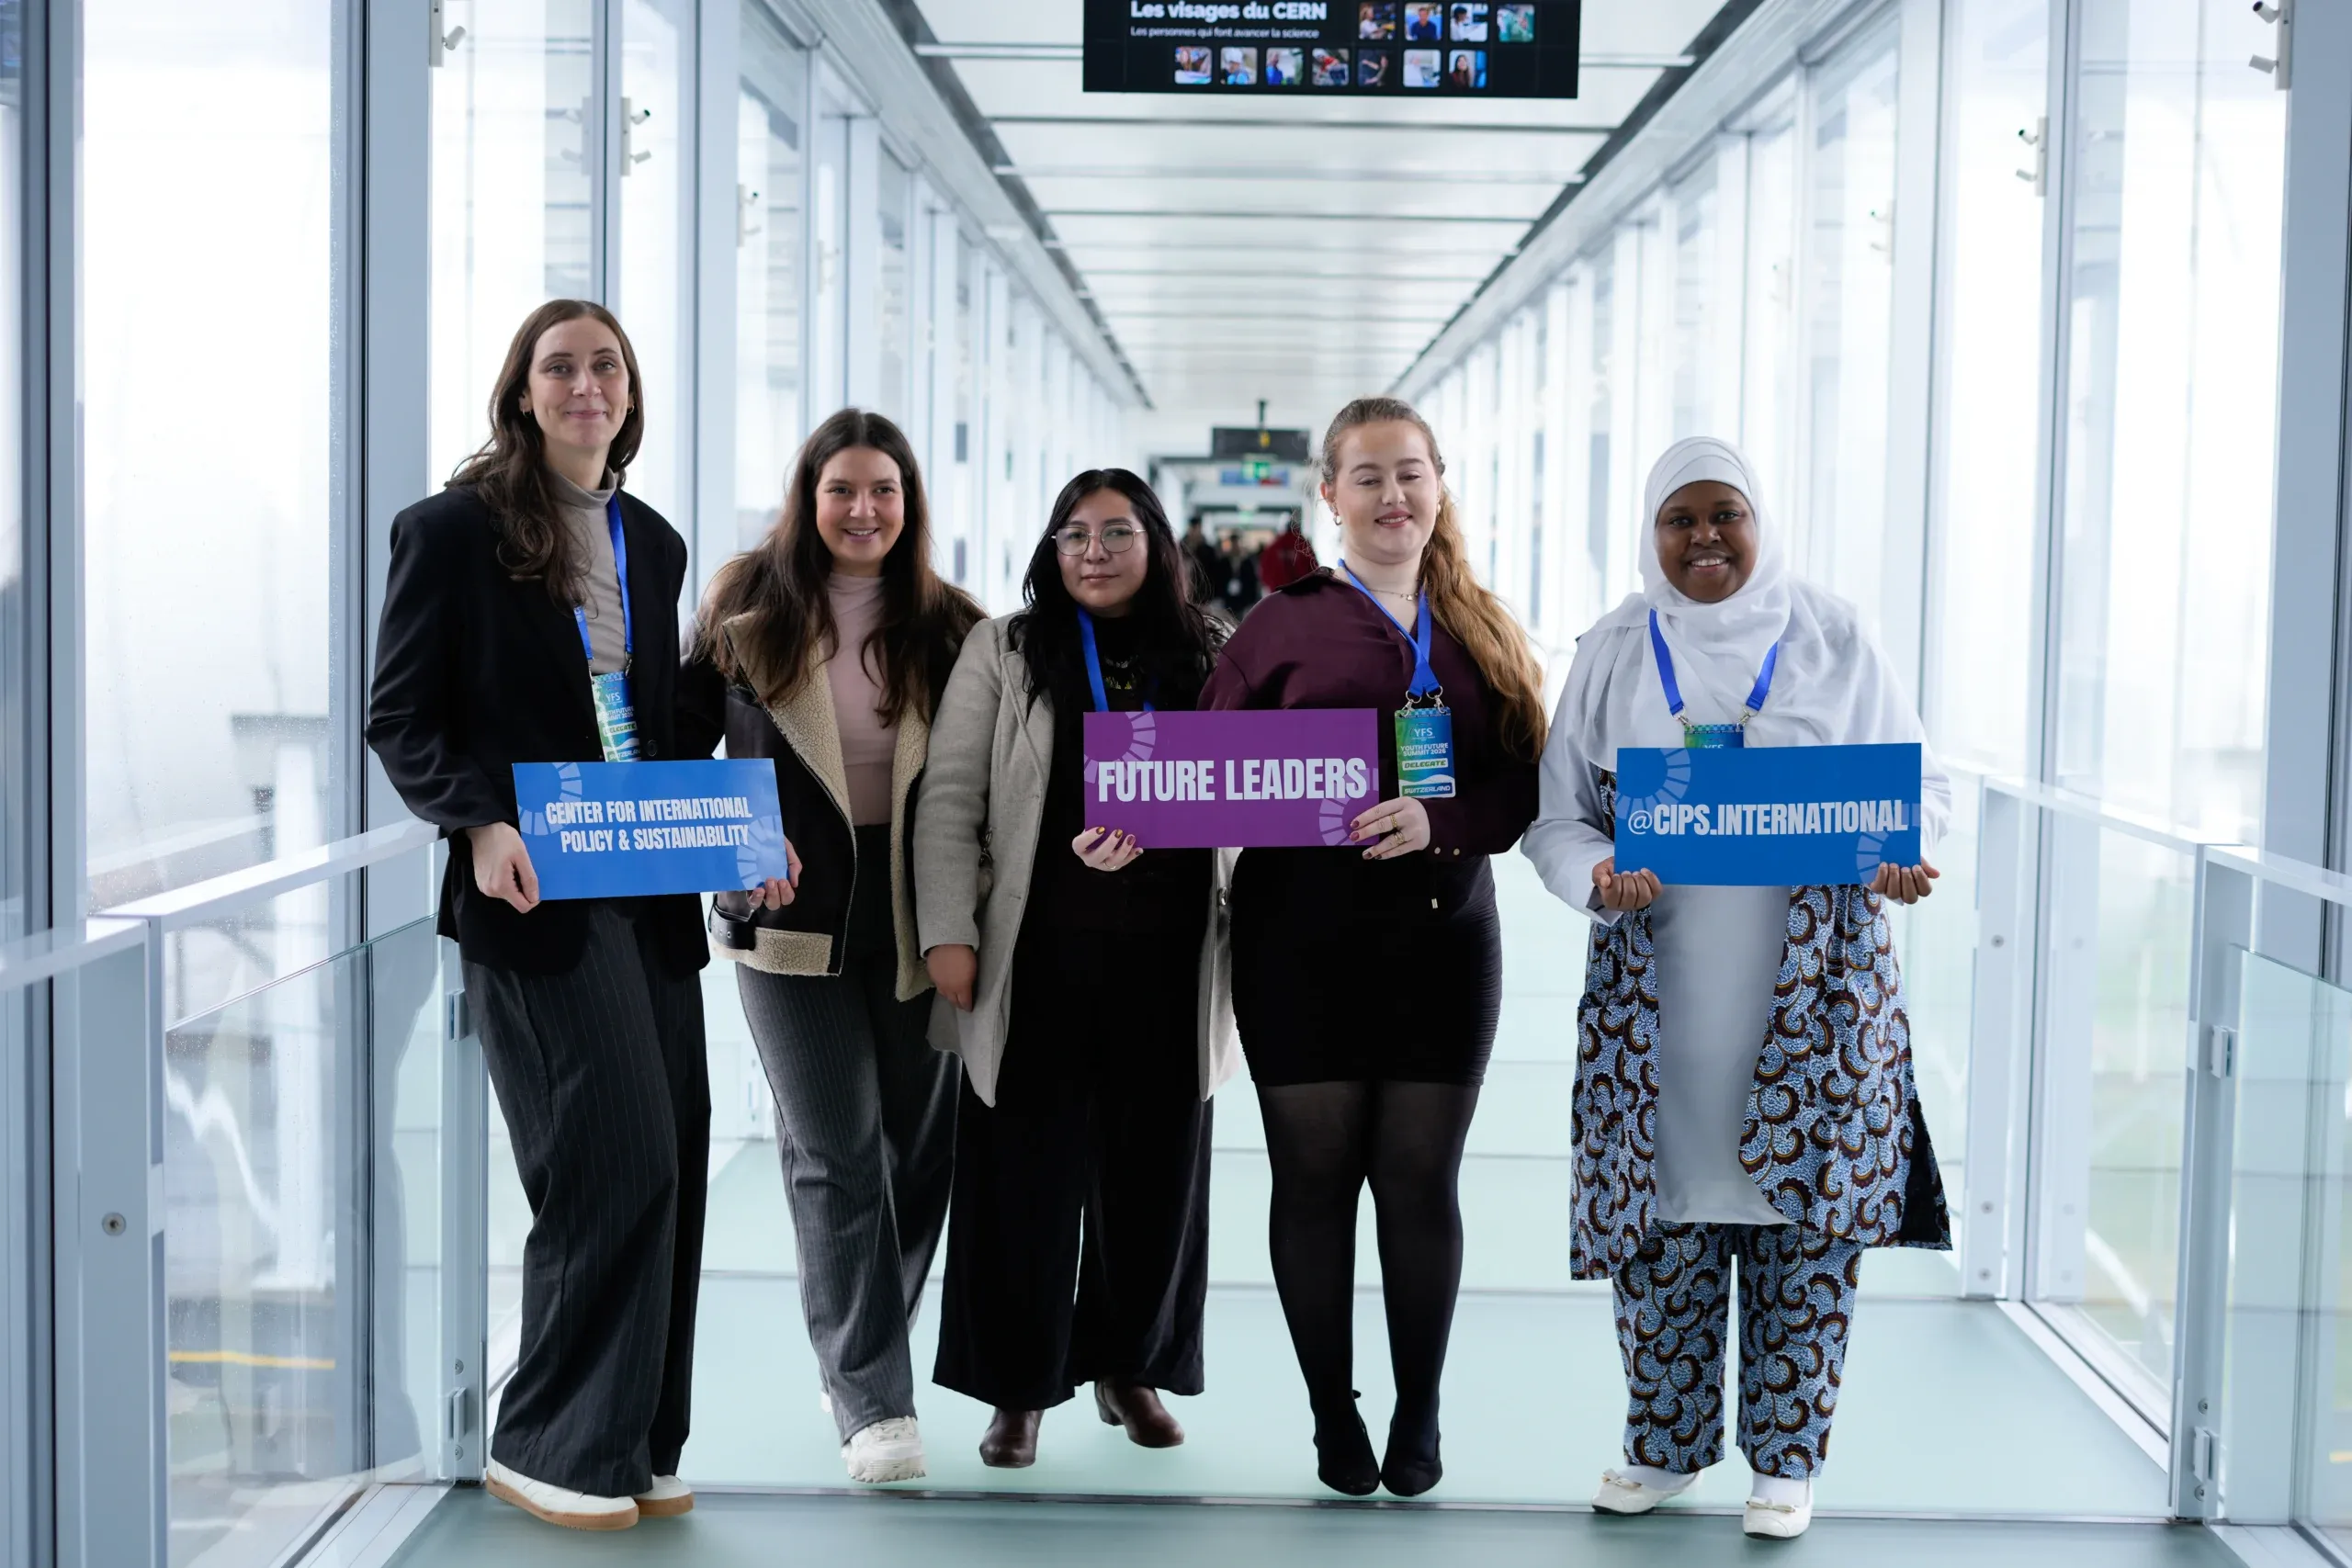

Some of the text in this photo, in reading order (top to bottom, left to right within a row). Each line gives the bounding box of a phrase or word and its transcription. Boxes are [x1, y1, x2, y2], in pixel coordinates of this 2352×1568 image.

[1131, 0, 1327, 22] Les visages du CERN
[1130, 27, 1319, 39] Les personnes qui font avancer la science
[605, 692, 621, 702] YFS
[1414, 728, 1433, 737] YFS
[1404, 760, 1446, 769] DELEGATE
[1098, 757, 1367, 802] FUTURE LEADERS
[1404, 785, 1451, 795] SWITZERLAND
[546, 796, 752, 825] CENTER FOR INTERNATIONAL
[1628, 799, 1908, 836] @CIPS.INTERNATIONAL
[560, 825, 749, 852] POLICY & SUSTAINABILITY
